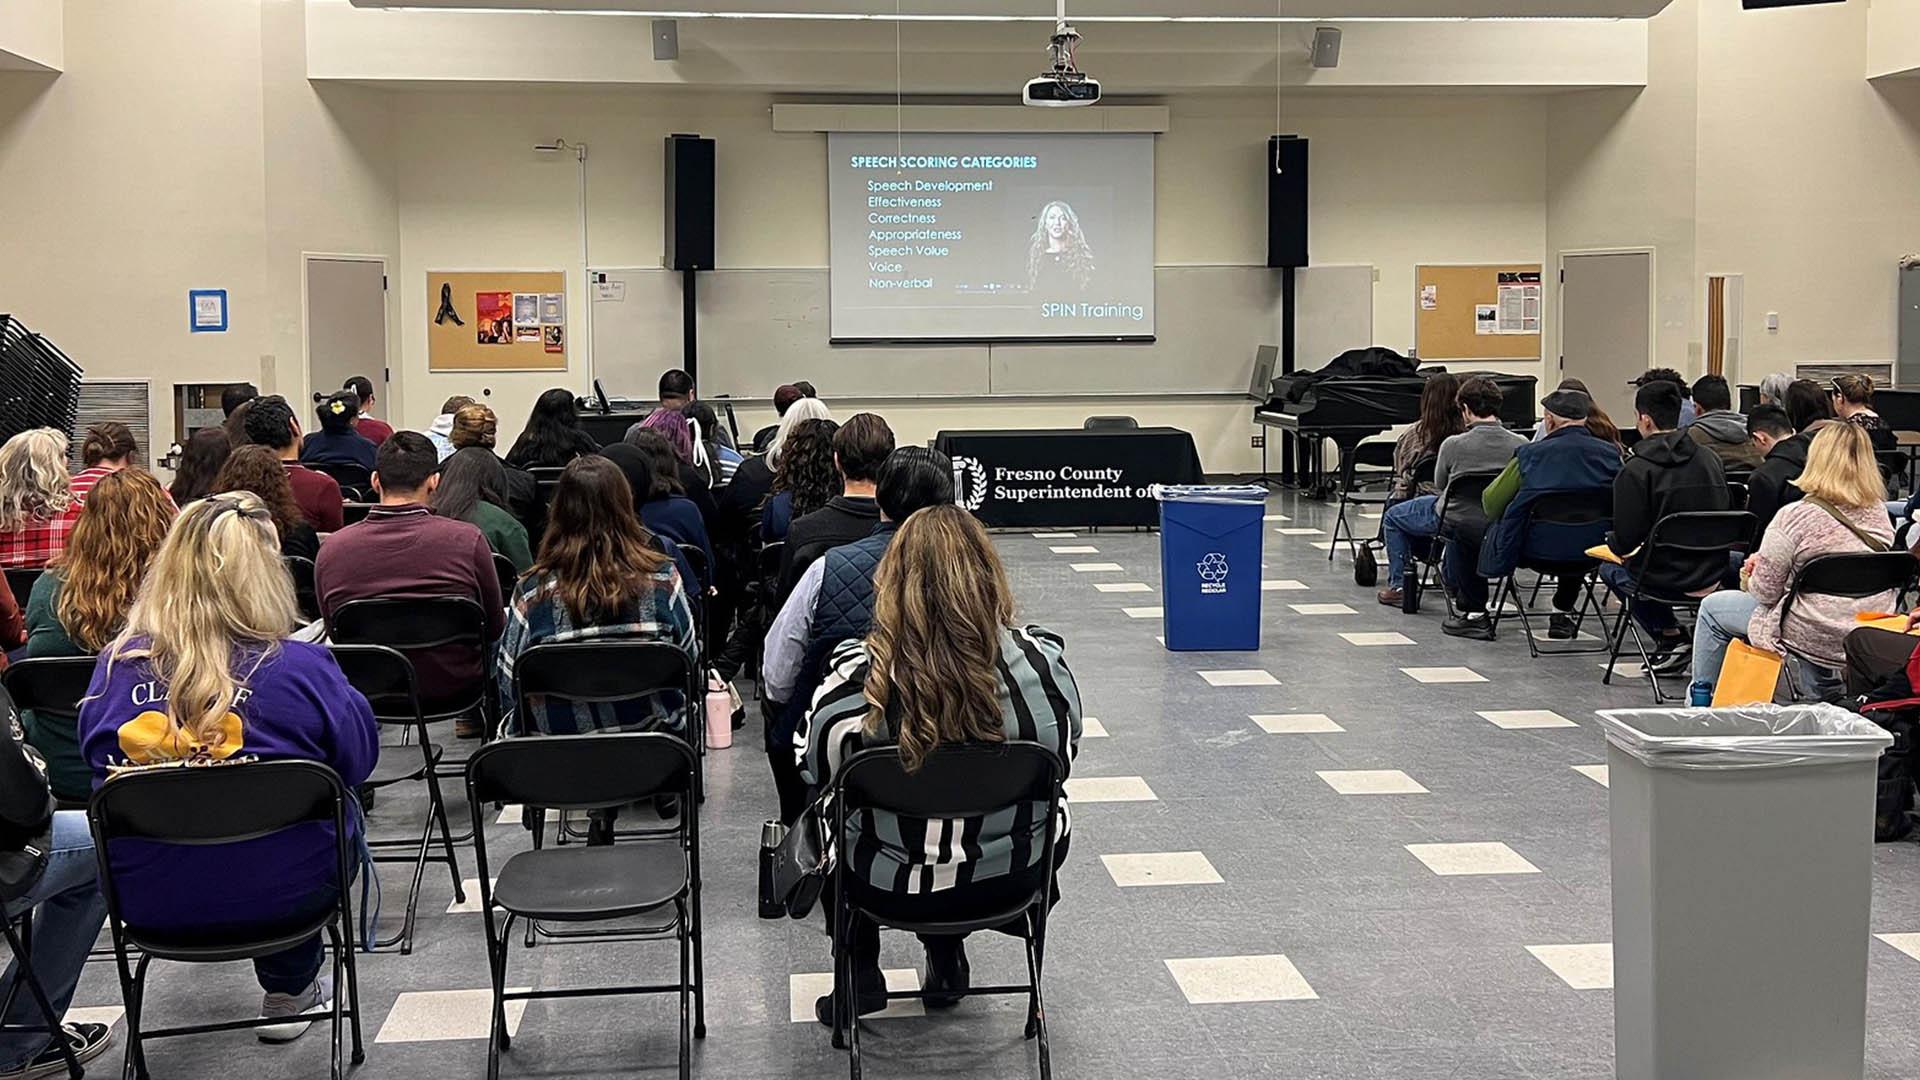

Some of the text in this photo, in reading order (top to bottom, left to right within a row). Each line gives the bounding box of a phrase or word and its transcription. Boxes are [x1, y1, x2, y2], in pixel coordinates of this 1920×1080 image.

[851, 156, 1038, 169] SPEECH SCORING CATEGORIES
[867, 180, 993, 193] Speech Development
[868, 196, 942, 208] Effectiveness
[868, 212, 936, 224] Correctness
[868, 229, 962, 241] Appropriateness
[868, 245, 949, 258] Speech Value
[868, 261, 903, 273] Voice
[868, 278, 933, 289] Non-verbal
[1041, 303, 1144, 321] SPIN Training
[994, 466, 1123, 483] Fresno County
[994, 484, 1154, 502] Superintendent of
